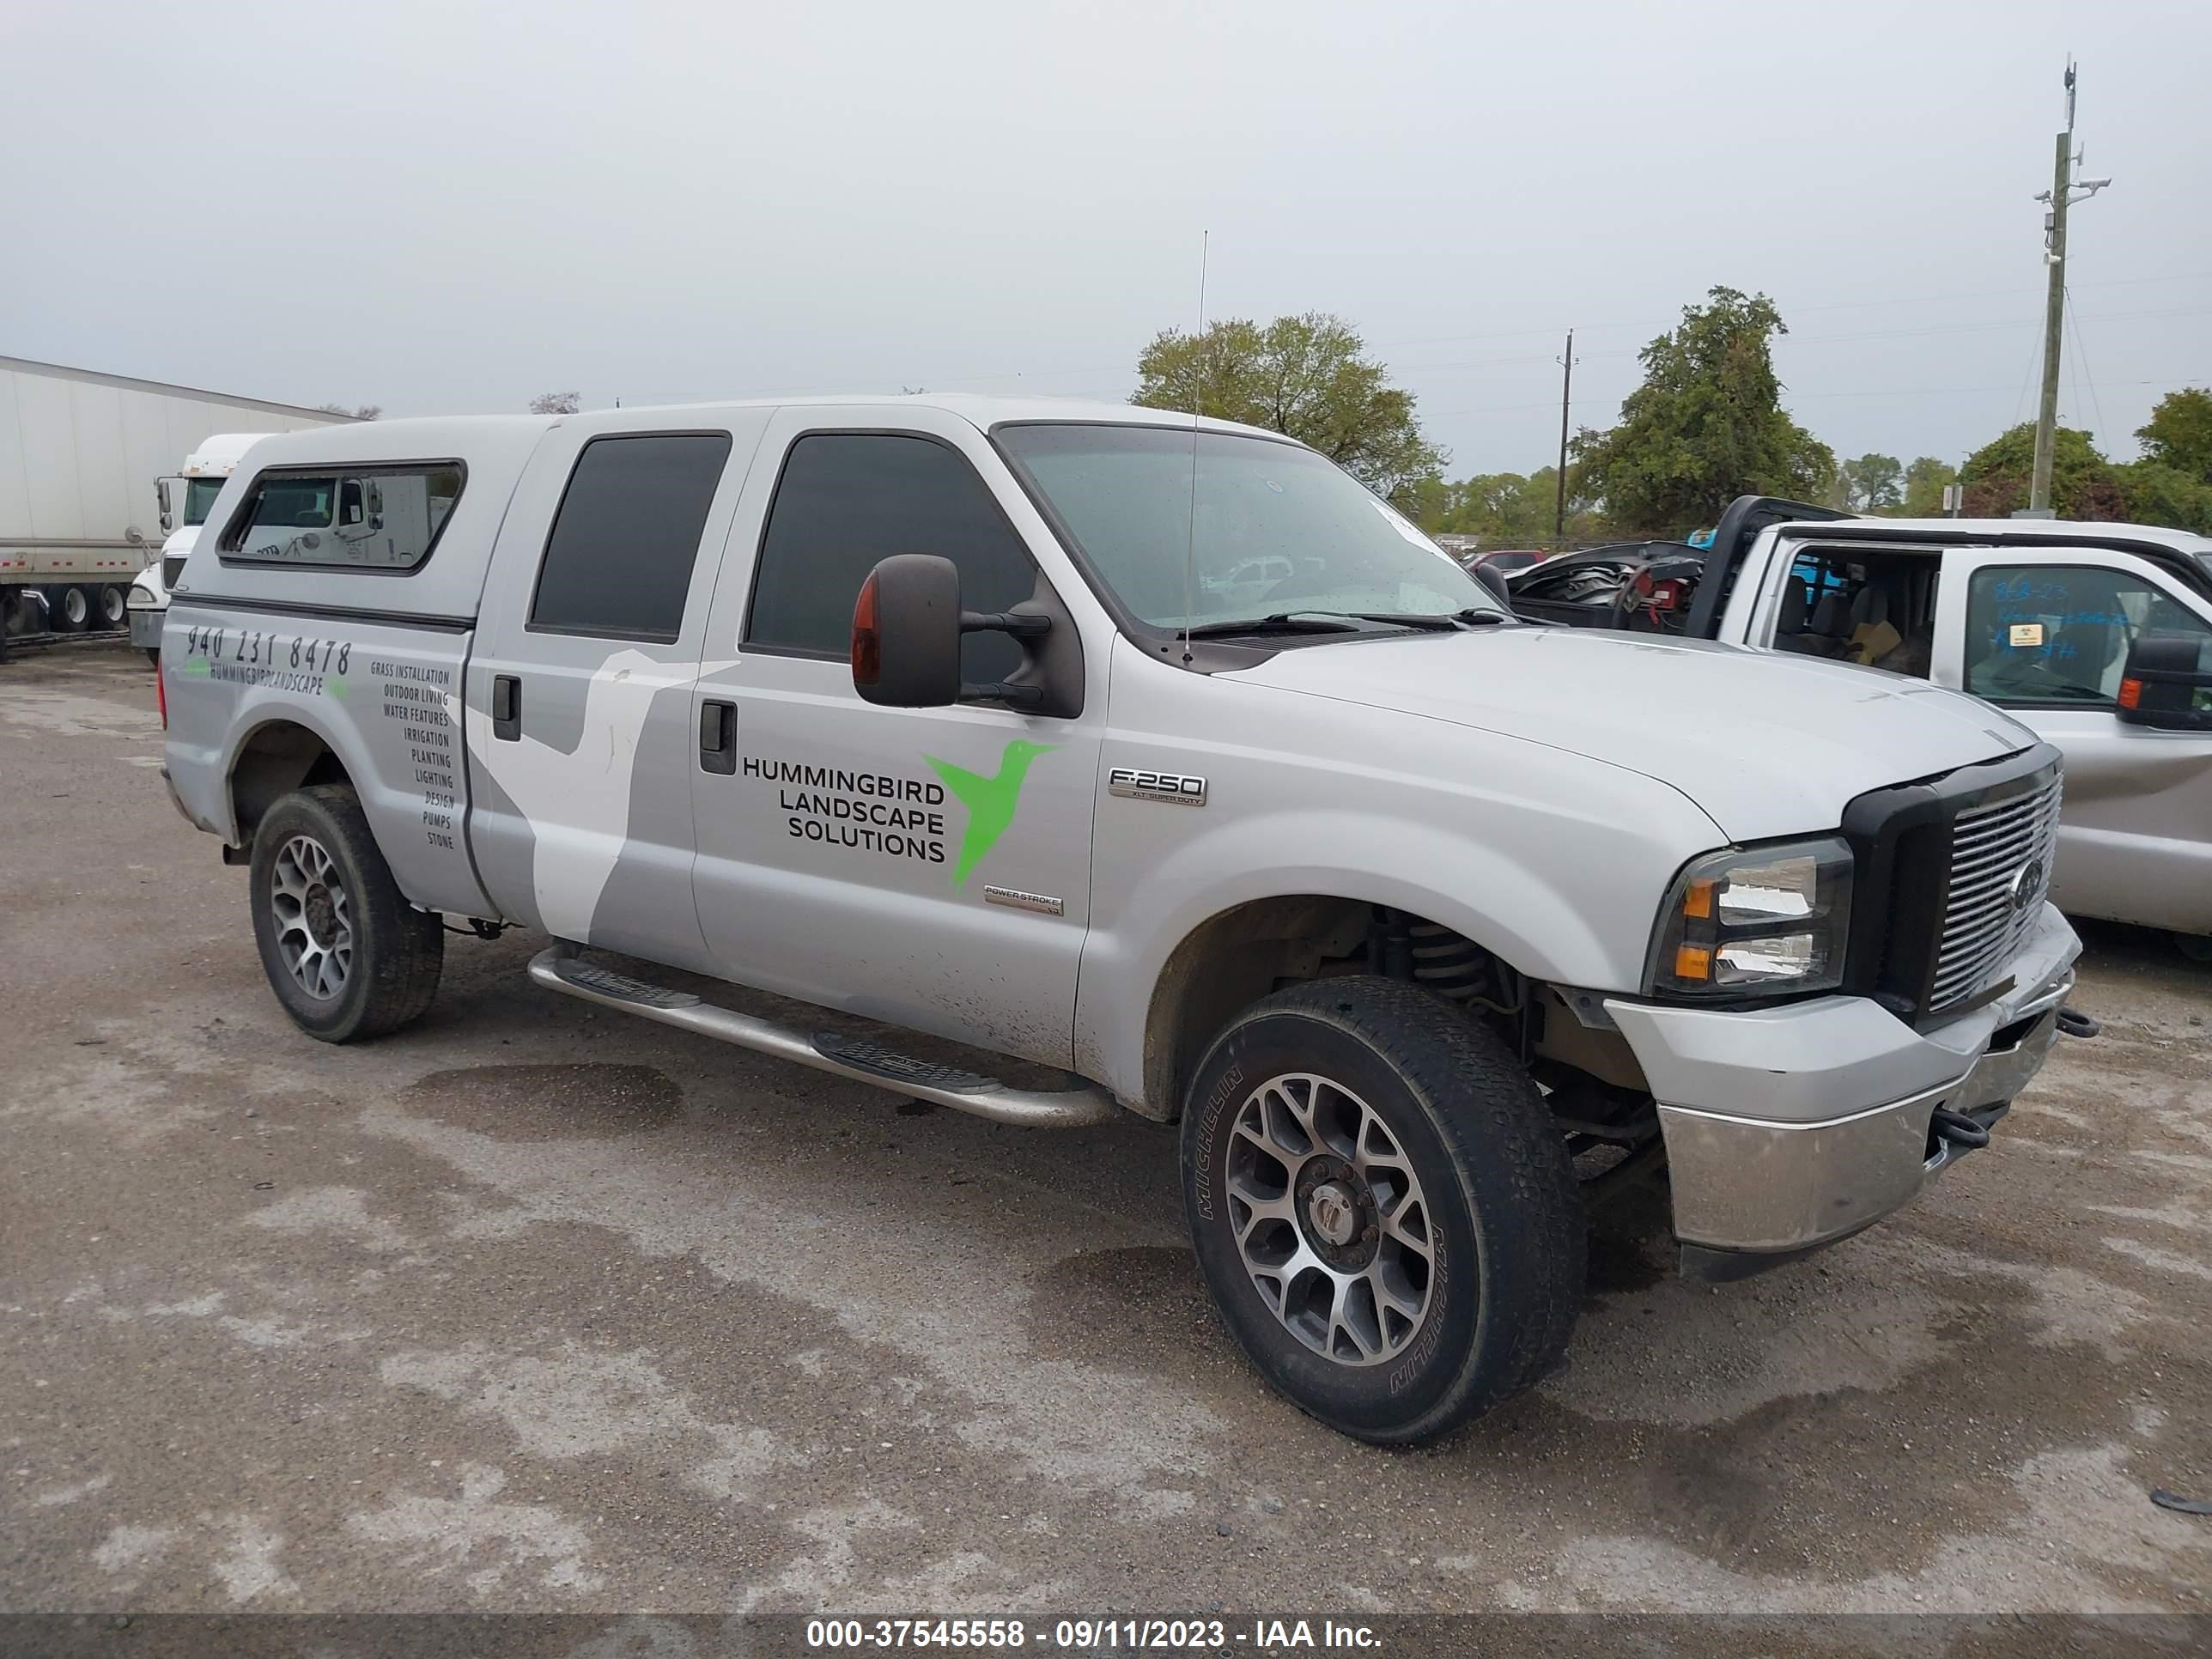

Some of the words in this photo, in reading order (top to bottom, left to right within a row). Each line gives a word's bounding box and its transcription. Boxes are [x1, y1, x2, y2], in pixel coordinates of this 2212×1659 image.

[188, 626, 224, 659] 940
[236, 630, 276, 665] 231
[289, 636, 351, 676] 8478
[210, 662, 323, 696] HUMMINGBIRDLANDSCAPE
[371, 661, 393, 677] GRASS
[395, 665, 449, 684] INSTALLATION
[384, 684, 419, 701] OUTDOOR
[422, 689, 448, 706] LIVING
[383, 703, 409, 720] WATER
[410, 708, 448, 726] FEATURES
[404, 727, 449, 747] IRRIGATION
[411, 748, 451, 769] PLANTING
[415, 769, 453, 789] LIGHTING
[743, 757, 945, 805] HUMMINGBIRD
[1109, 769, 1203, 796] F-250
[425, 791, 454, 810] DESIGN
[1177, 796, 1202, 805] DUTY
[422, 811, 451, 830] PUMPS
[780, 789, 944, 836] LANDSCAPE
[428, 832, 454, 850] STONE
[787, 817, 945, 863] SOLUTIONS
[1195, 1065, 1243, 1220] MICHELIN
[1389, 1222, 1449, 1396] MICHELIN
